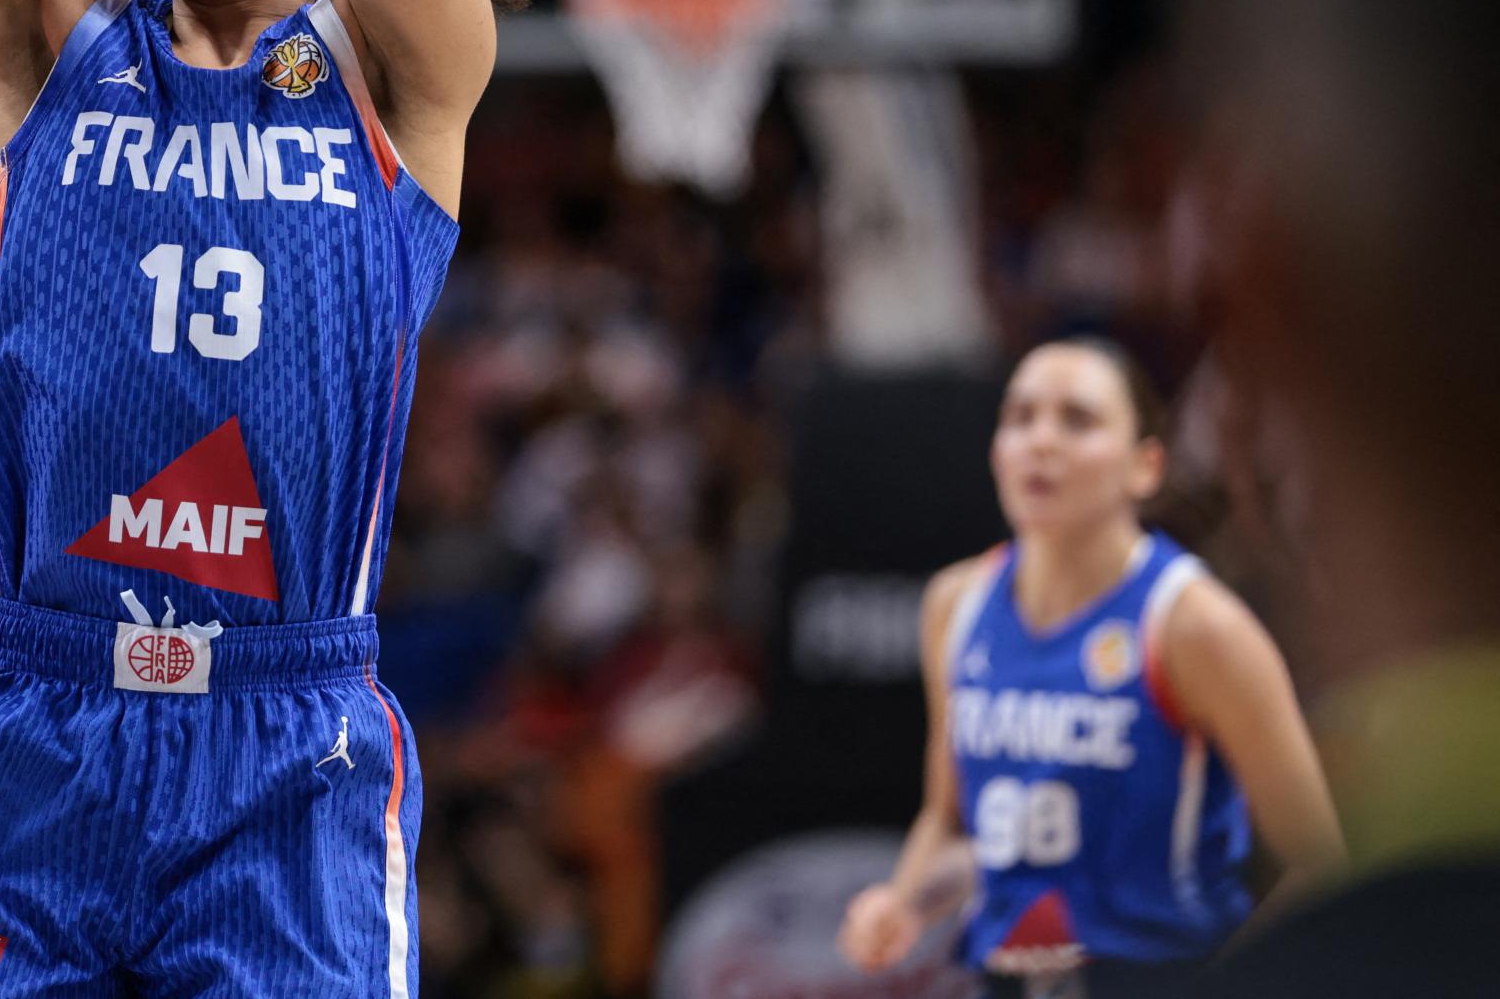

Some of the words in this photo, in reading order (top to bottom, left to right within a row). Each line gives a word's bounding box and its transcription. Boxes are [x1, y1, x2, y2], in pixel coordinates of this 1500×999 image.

[62, 111, 357, 208] FRANCE
[140, 243, 265, 362] 13
[108, 493, 268, 556] MAIF
[153, 634, 167, 685] FRA
